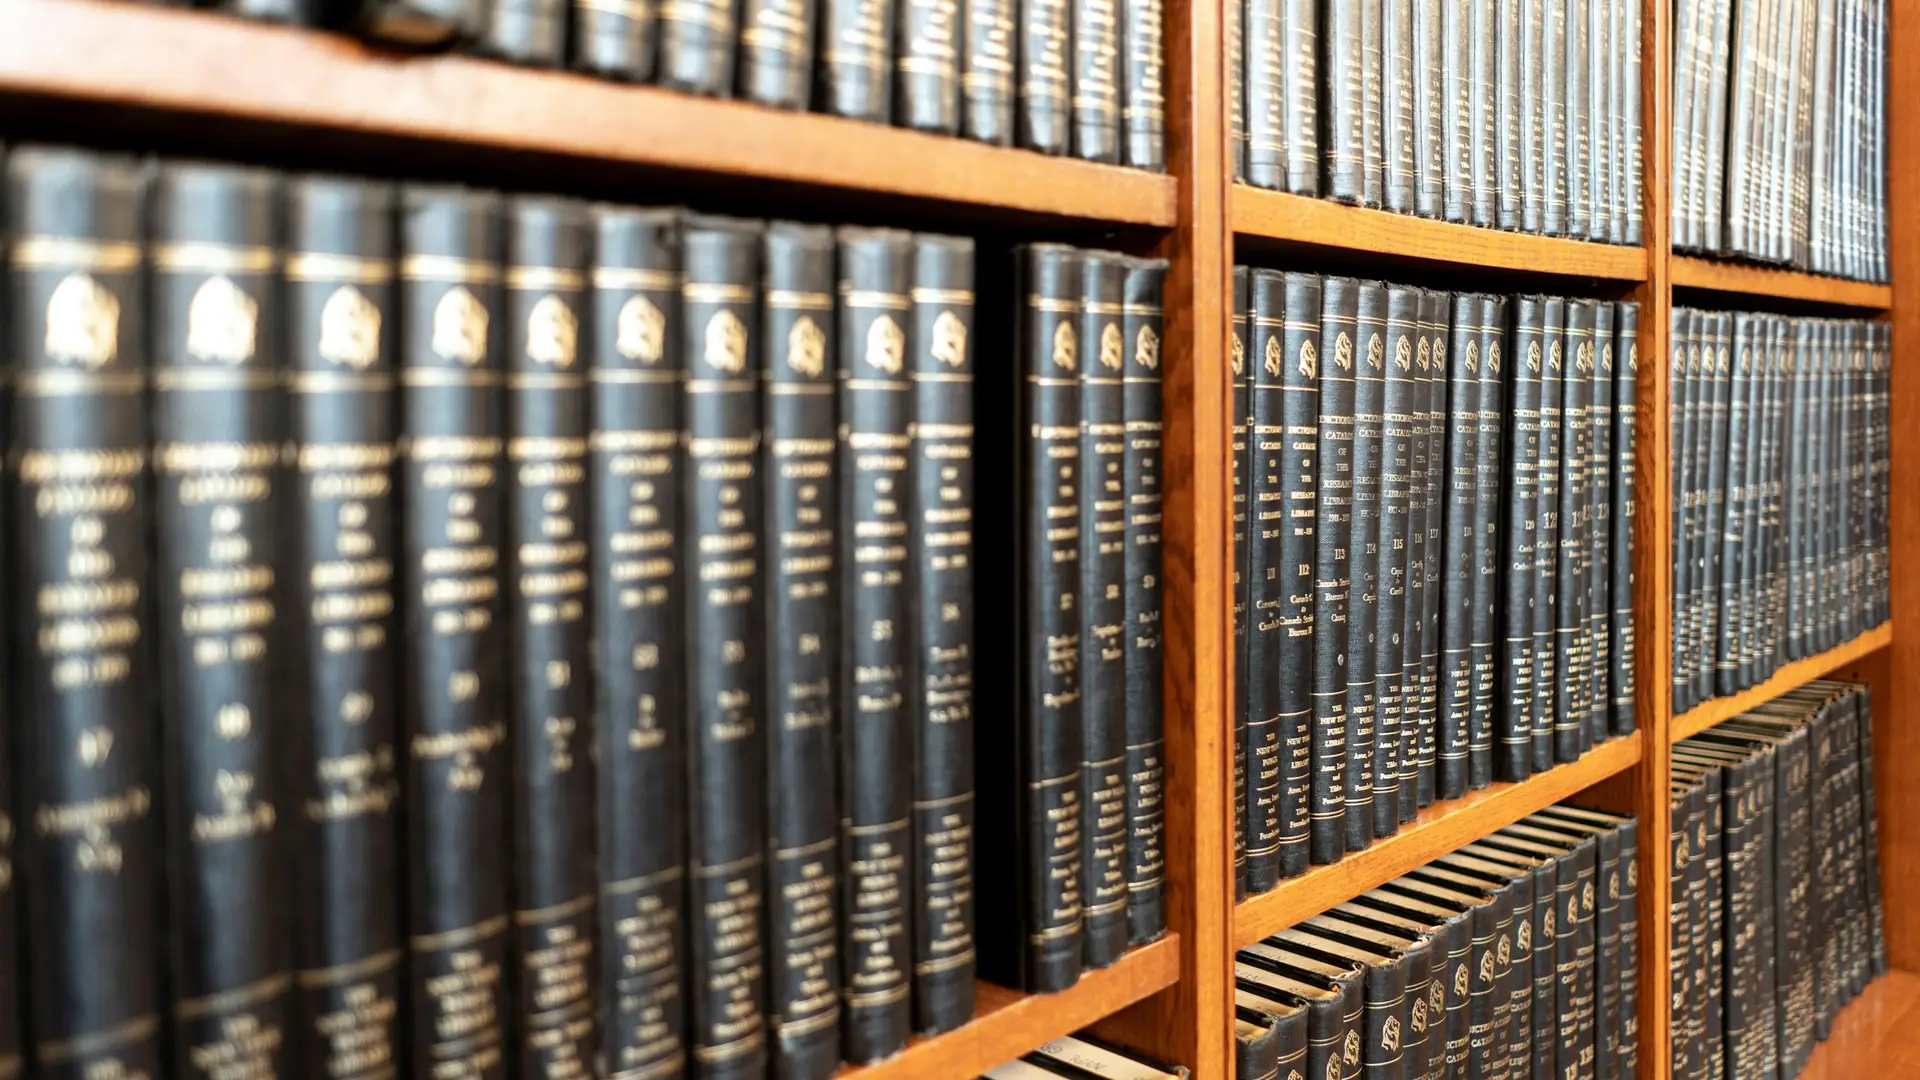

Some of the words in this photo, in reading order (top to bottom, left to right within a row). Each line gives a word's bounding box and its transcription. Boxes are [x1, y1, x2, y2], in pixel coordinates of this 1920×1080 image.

[1525, 520, 1534, 530] 120
[1366, 543, 1376, 554] 114
[1393, 539, 1403, 549] 115
[1334, 549, 1345, 560] 113
[1298, 564, 1309, 576] 112
[1297, 724, 1306, 732] THE
[1327, 726, 1344, 736] PUBLIC
[1325, 738, 1345, 748] LIBRARY
[1257, 747, 1270, 755] NEW
